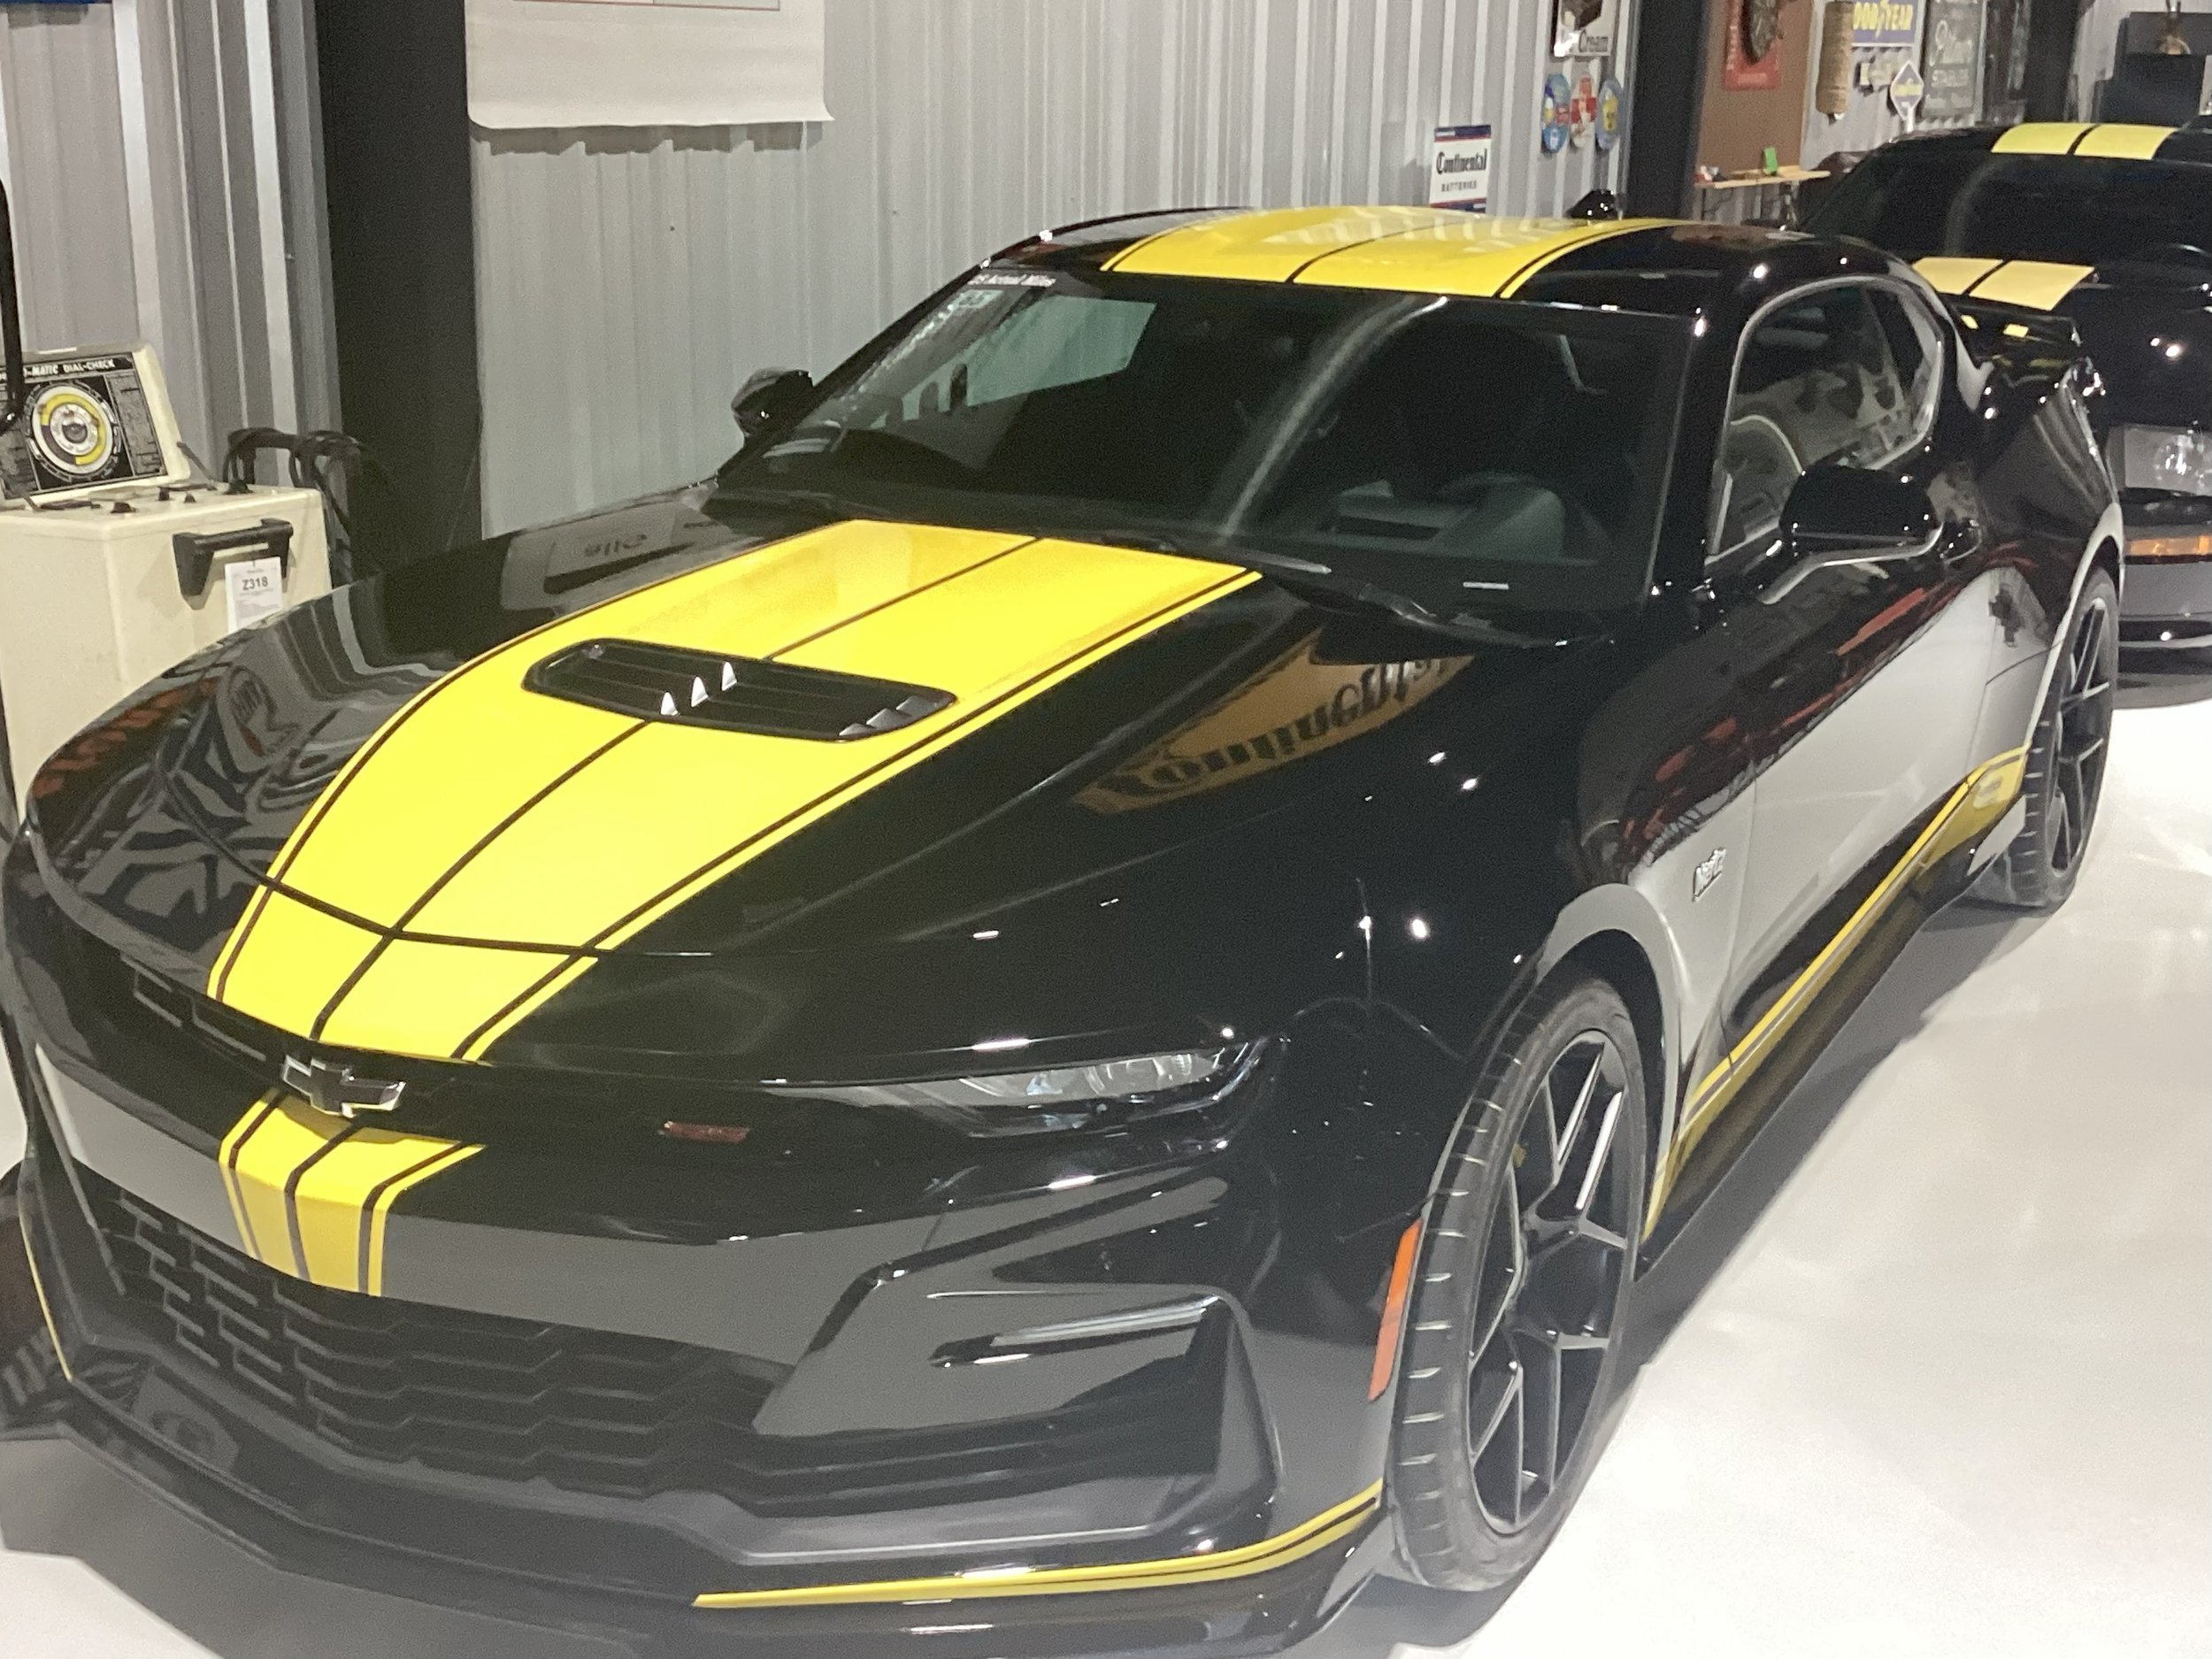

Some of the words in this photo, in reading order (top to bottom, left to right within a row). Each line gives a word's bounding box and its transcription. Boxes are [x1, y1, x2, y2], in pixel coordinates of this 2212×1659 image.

[1436, 148, 1487, 175] Continental
[1441, 180, 1477, 192] BATTERIES
[242, 576, 268, 591] Z318
